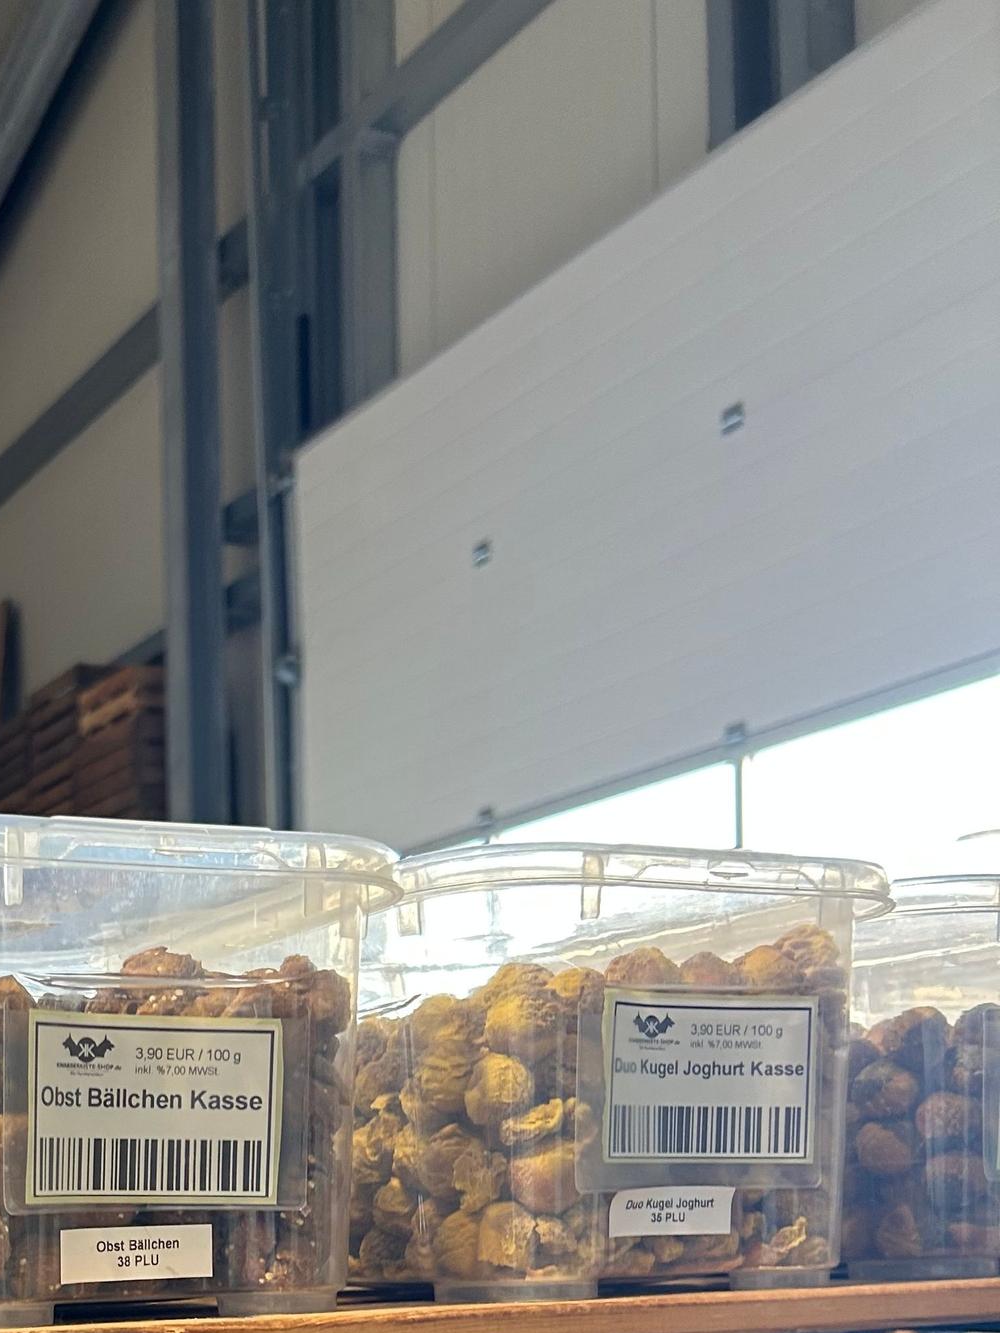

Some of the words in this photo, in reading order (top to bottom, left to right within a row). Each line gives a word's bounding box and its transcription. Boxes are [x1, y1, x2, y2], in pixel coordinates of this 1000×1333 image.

[690, 1023, 713, 1036] 3,90
[716, 1024, 740, 1036] EUR
[752, 1025, 773, 1036] 100
[776, 1027, 783, 1038] g
[135, 1047, 163, 1061] 3,90
[167, 1048, 195, 1061] EUR
[207, 1049, 230, 1061] 100
[233, 1052, 241, 1064] g
[157, 1065, 186, 1076] %7,00
[615, 1057, 637, 1074] Duo
[640, 1059, 679, 1078] Kugel
[683, 1061, 744, 1079] Joghurt
[751, 1061, 804, 1076] Kasse
[41, 1085, 82, 1107] Obst
[88, 1087, 182, 1109] Bällchen
[190, 1090, 263, 1110] Kasse
[625, 1199, 644, 1210] Duo
[646, 1198, 673, 1211] Kugel
[676, 1198, 714, 1211] Joghurt
[665, 1212, 686, 1223] PLU
[96, 1240, 125, 1253] Obst
[129, 1238, 180, 1251] Bällchen
[117, 1256, 131, 1267] 38
[135, 1255, 160, 1267] PLU
